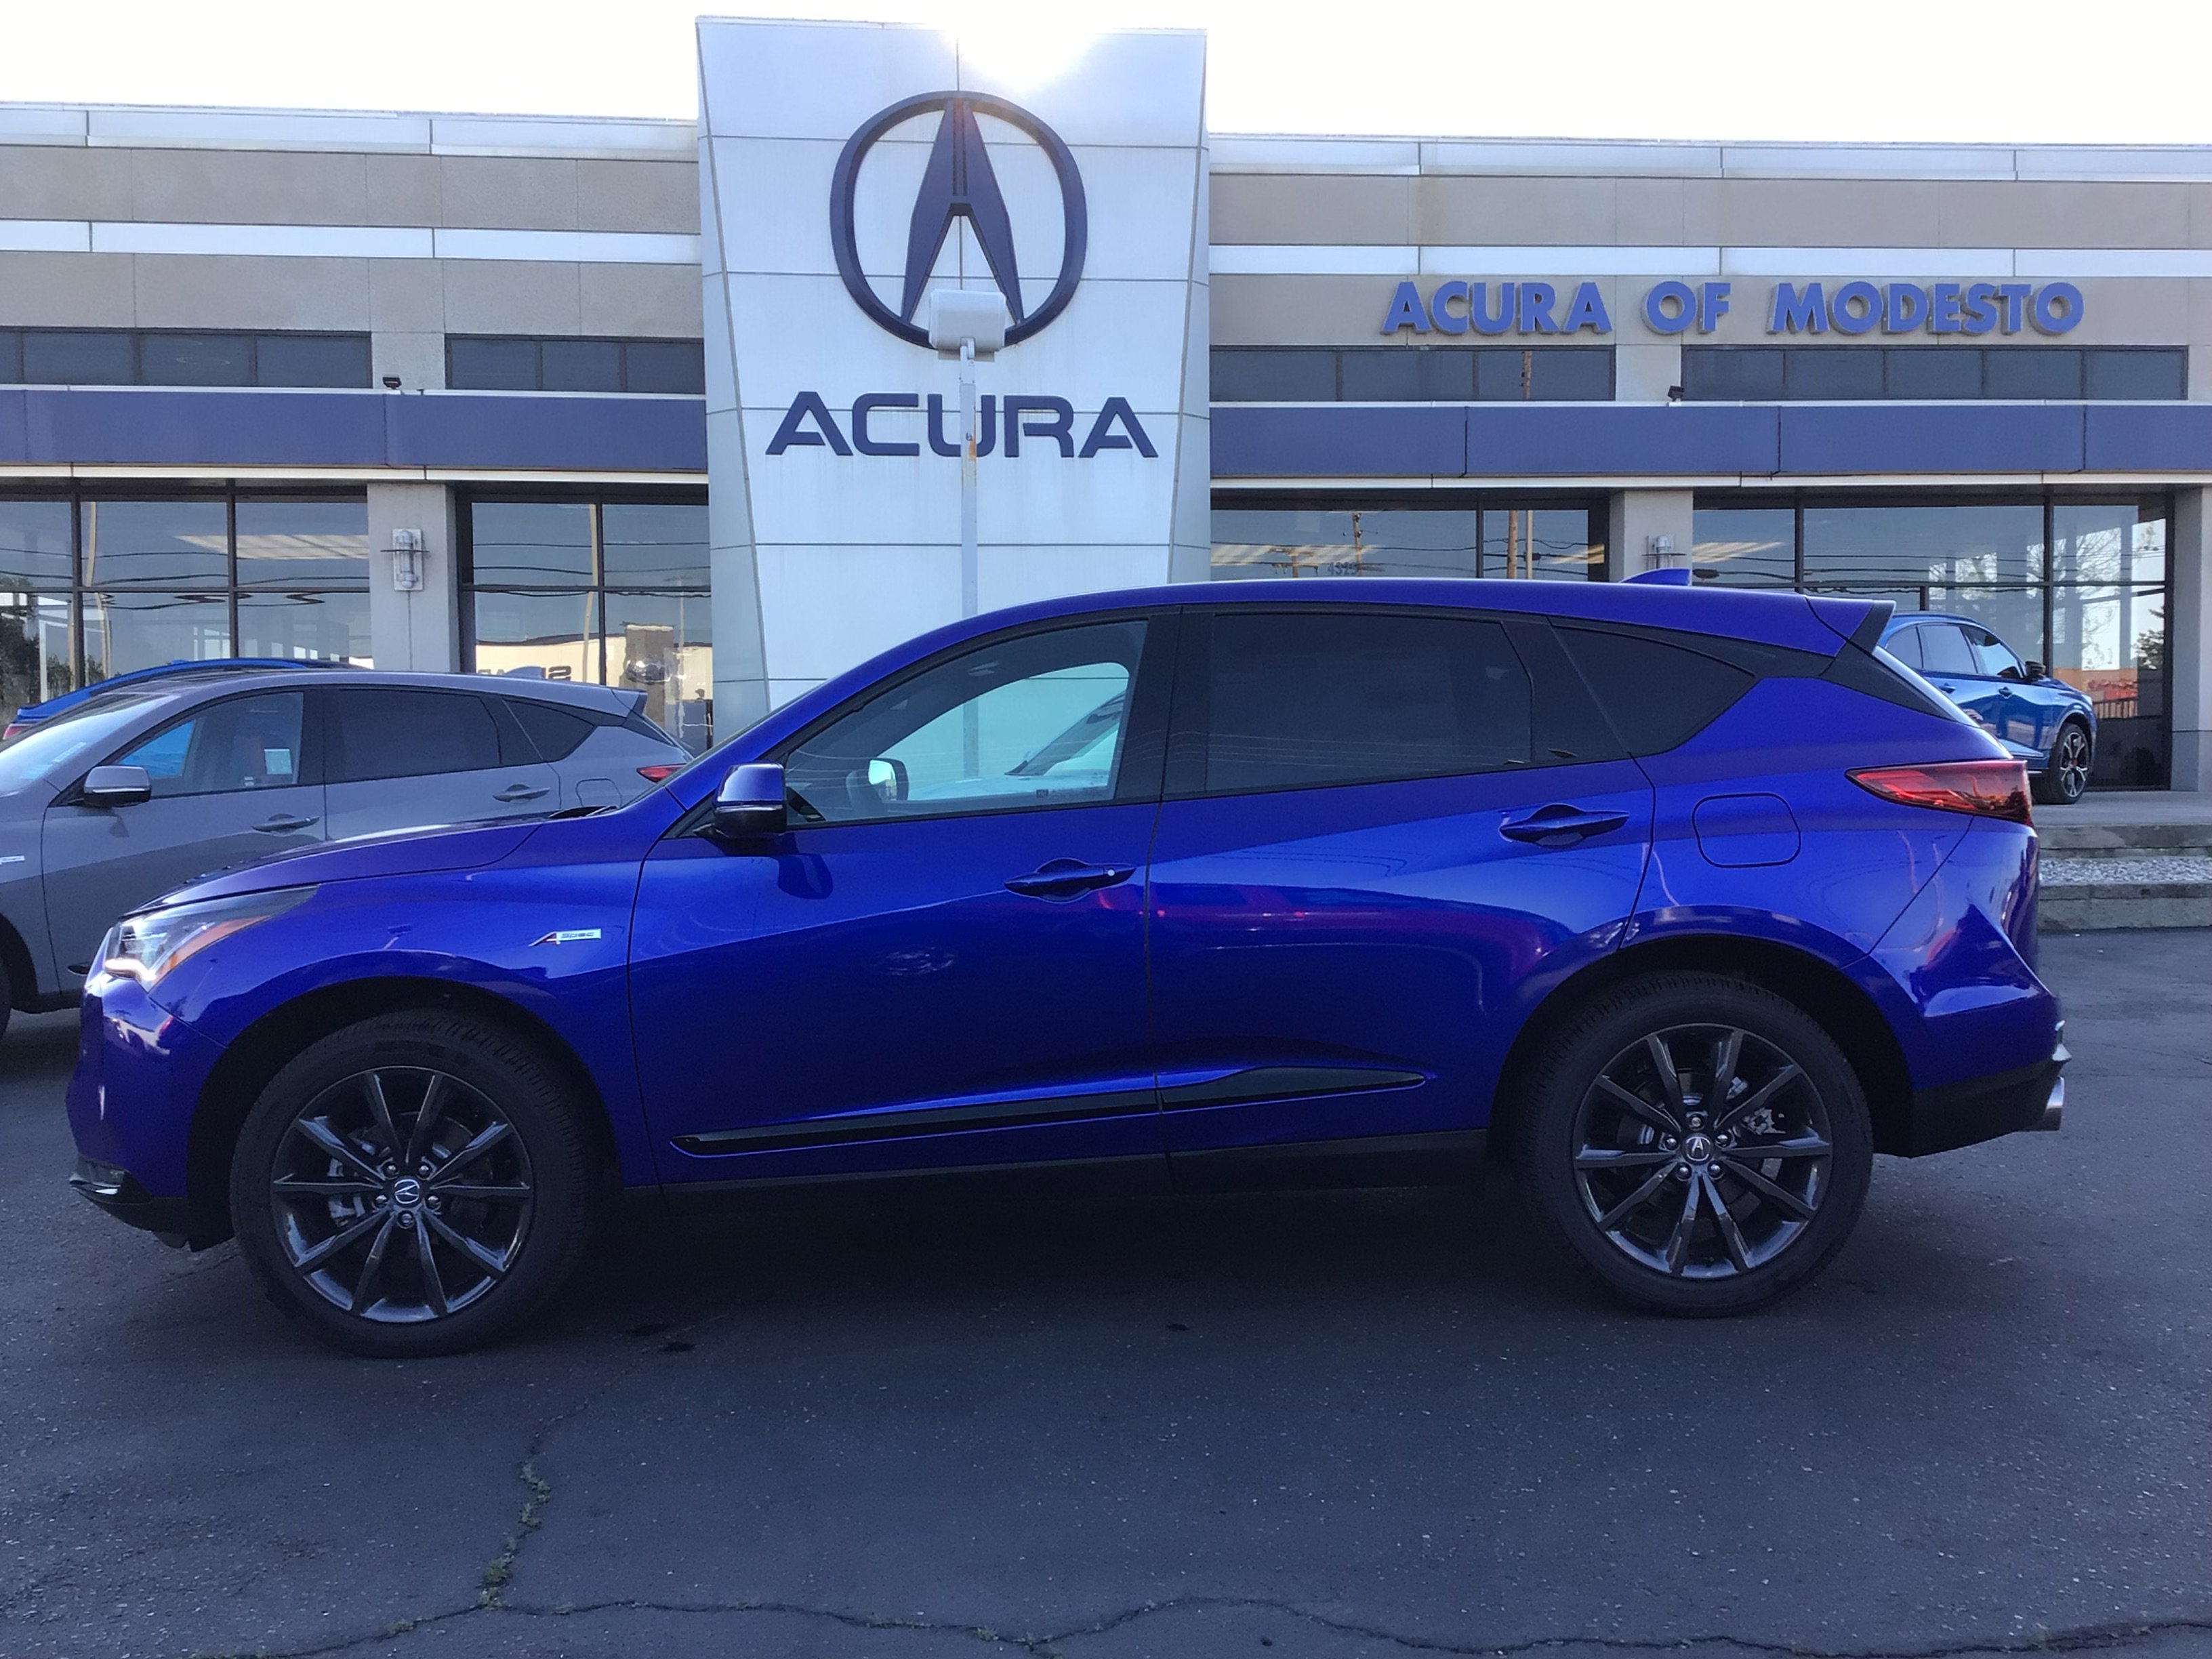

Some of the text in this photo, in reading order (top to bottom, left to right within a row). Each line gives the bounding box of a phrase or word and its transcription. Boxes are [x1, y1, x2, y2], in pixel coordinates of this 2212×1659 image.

[1380, 281, 2084, 335] ACURA OF MODESTO
[765, 391, 1159, 458] ACURA
